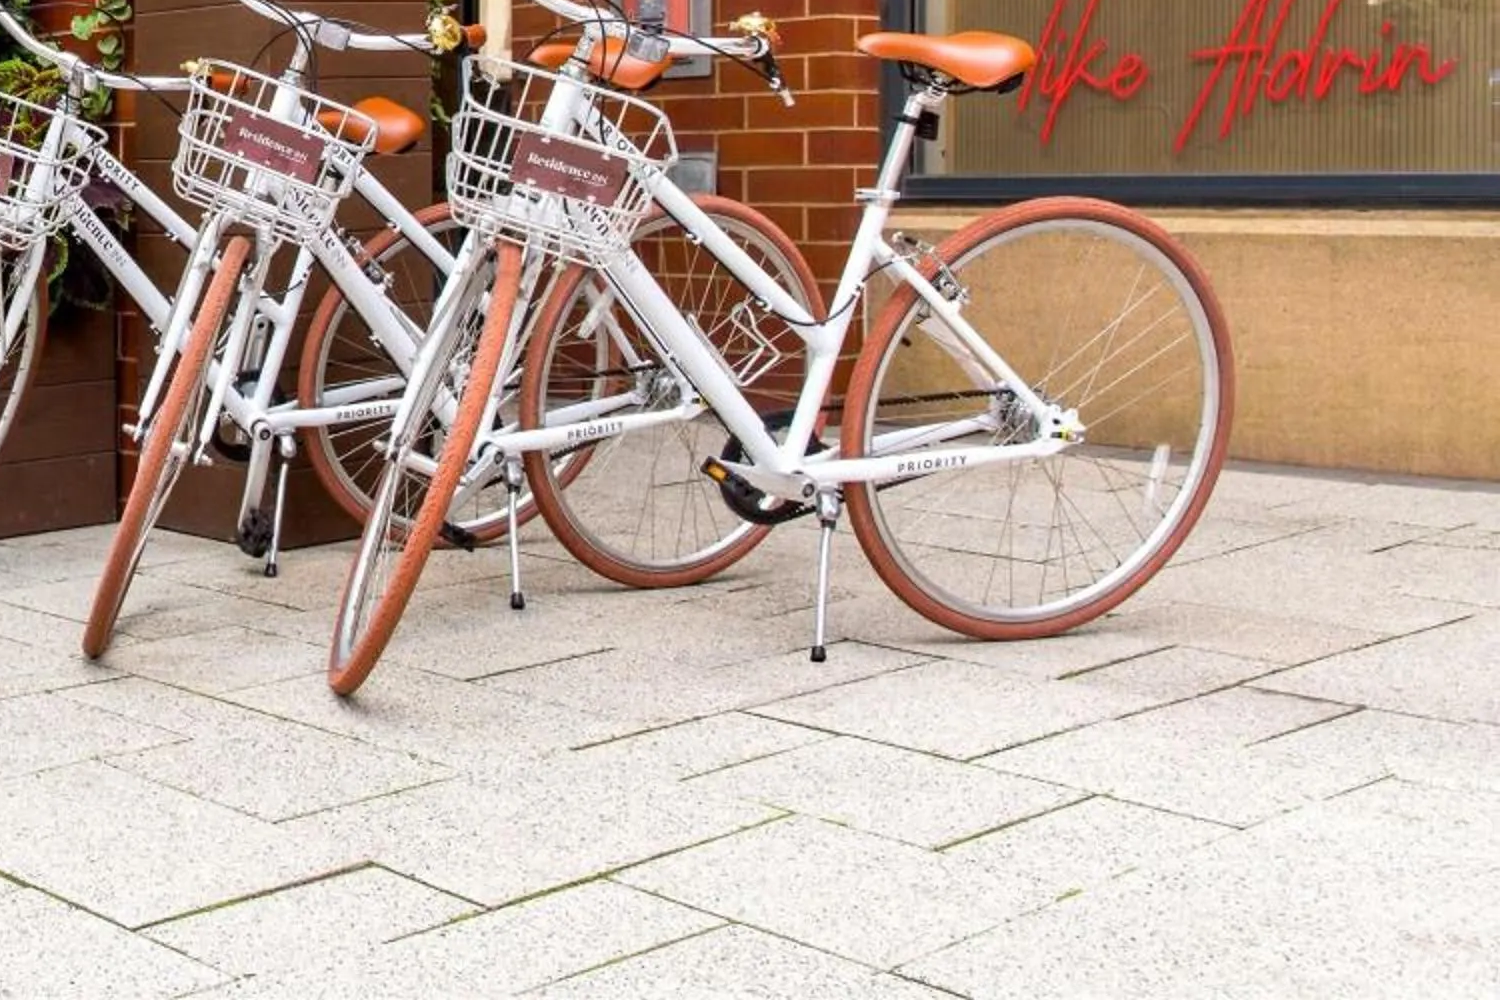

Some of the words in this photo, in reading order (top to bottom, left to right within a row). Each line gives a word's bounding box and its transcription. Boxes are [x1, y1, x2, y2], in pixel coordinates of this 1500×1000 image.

[337, 404, 392, 420] PRIORITY
[567, 421, 623, 440] PRIORITY
[897, 455, 967, 473] PRIORITY
